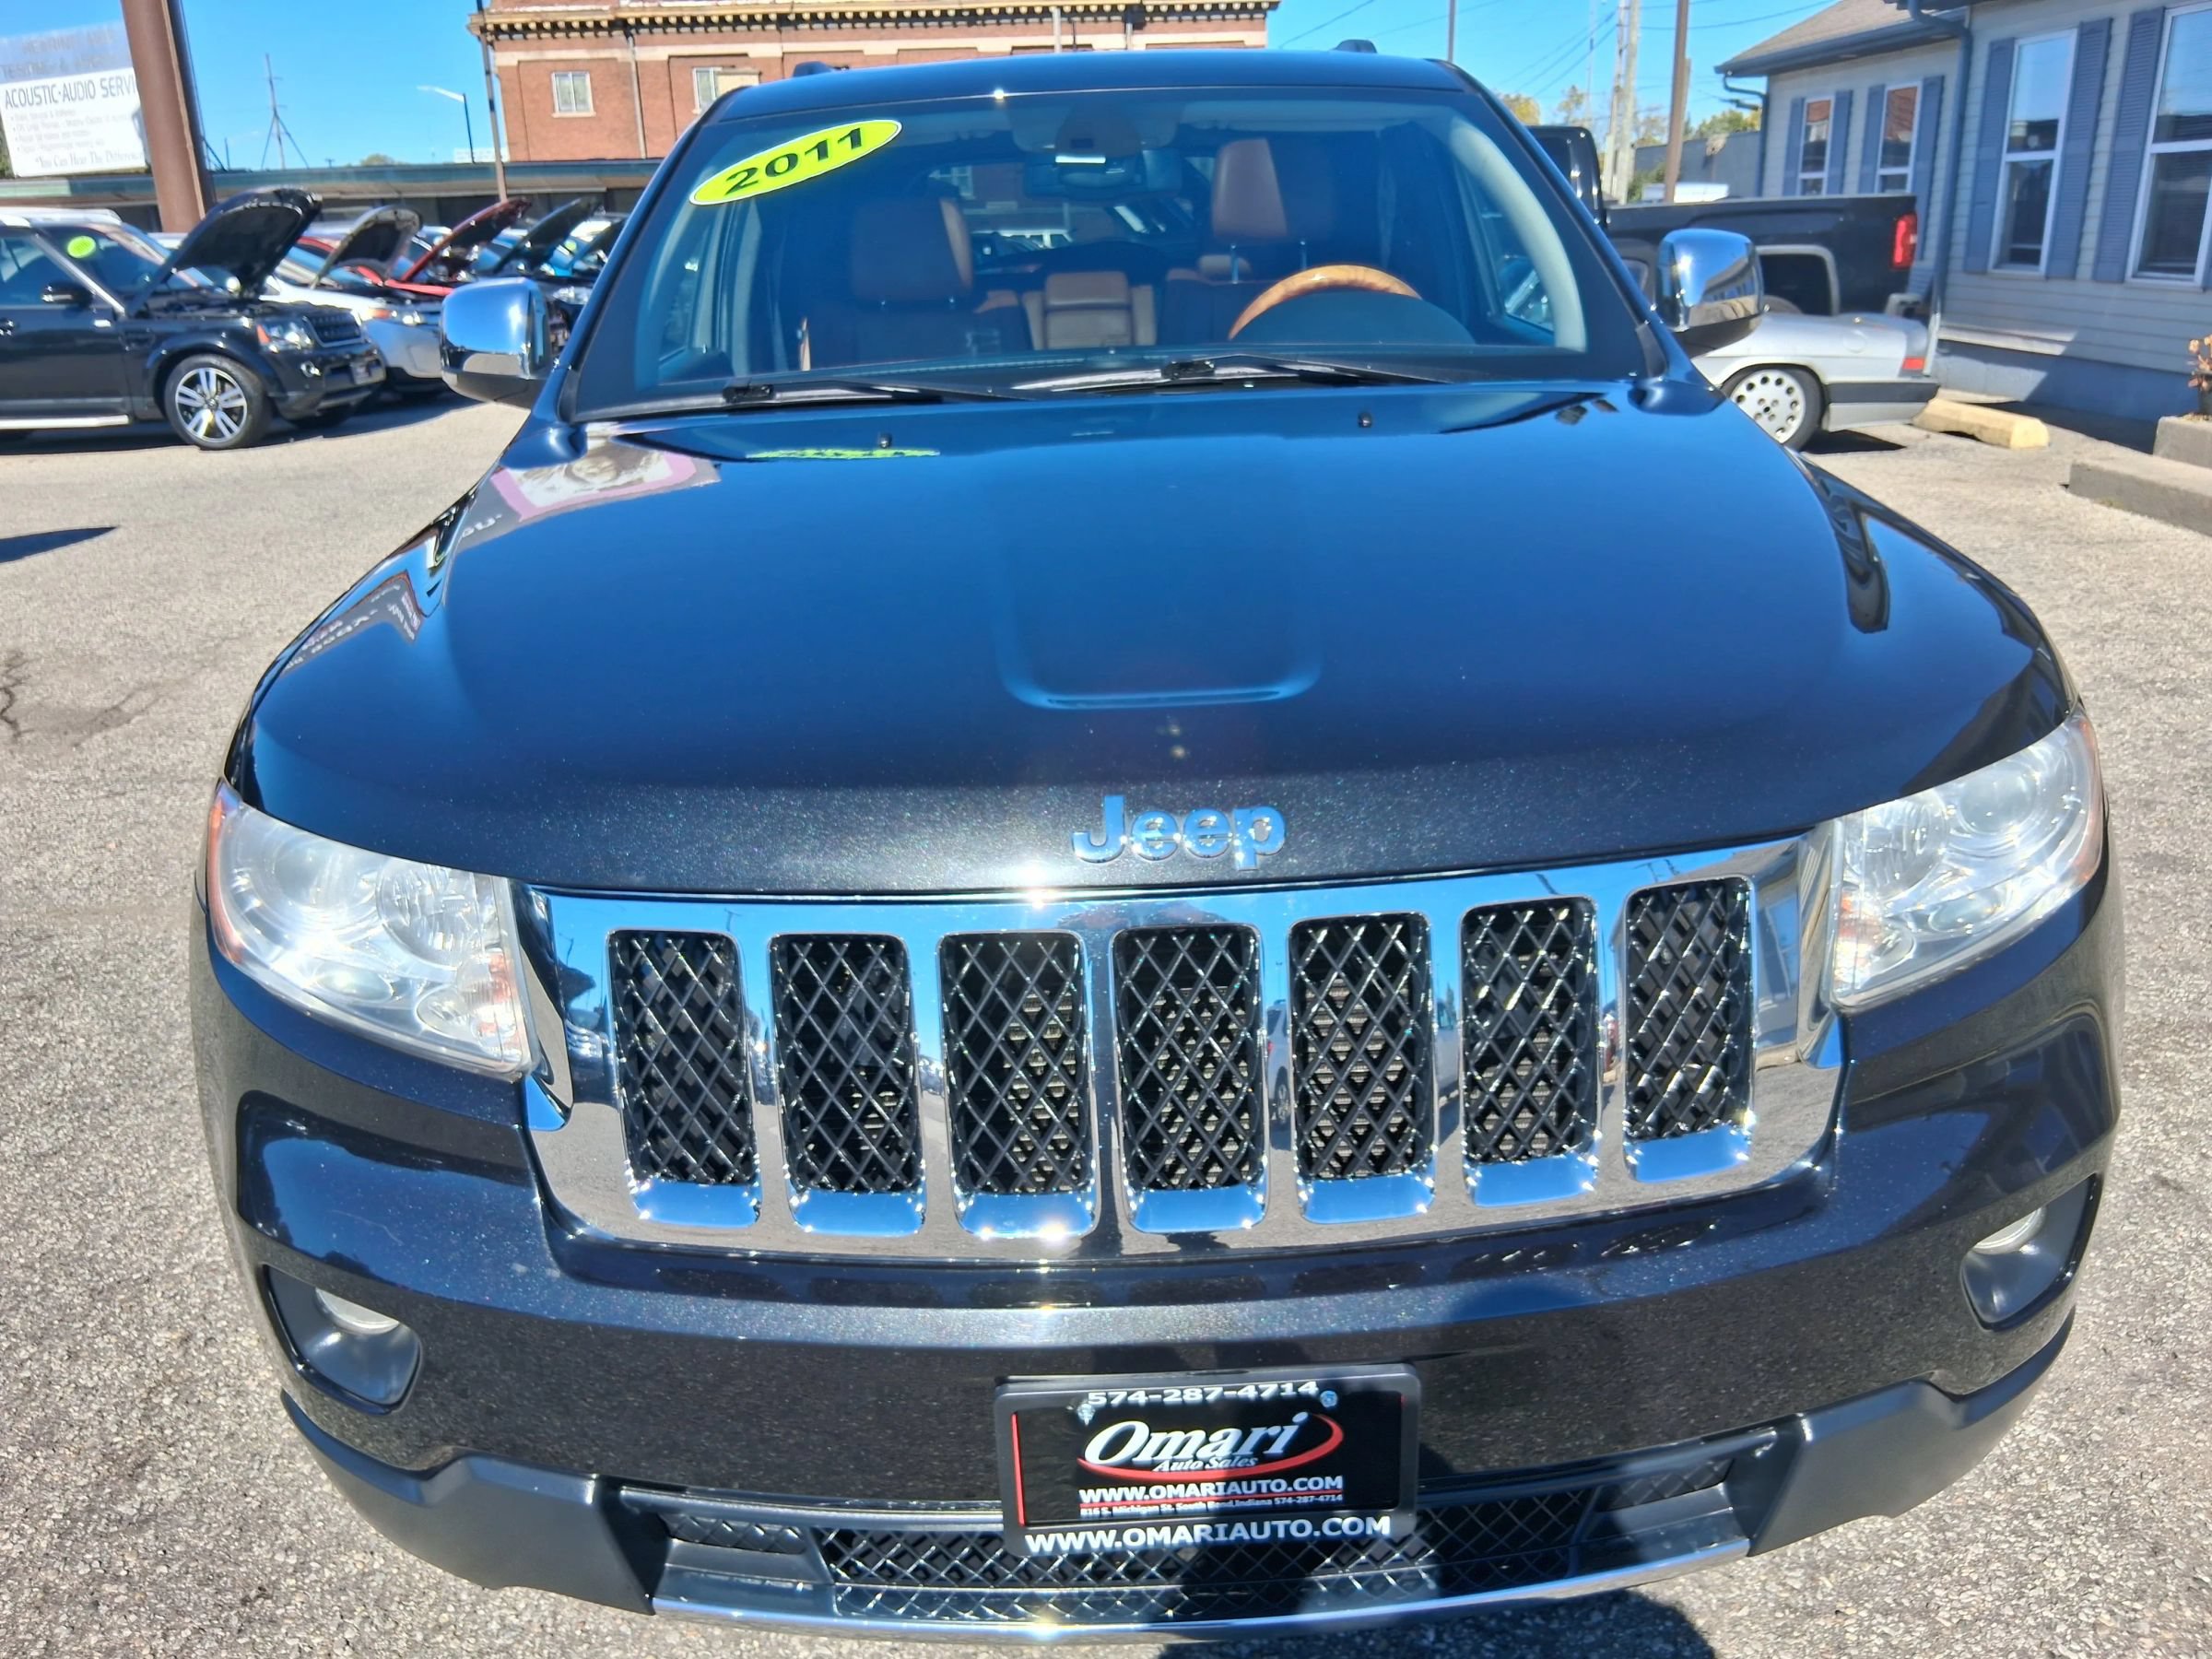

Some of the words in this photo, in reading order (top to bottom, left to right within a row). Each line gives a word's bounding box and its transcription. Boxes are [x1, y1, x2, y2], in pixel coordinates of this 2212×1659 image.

[100, 74, 136, 99] SERVI
[724, 127, 862, 196] 2011
[1072, 795, 1285, 871] Jeep
[1088, 1381, 1319, 1406] 574-287-4714
[1084, 1411, 1310, 1466] Omari
[1152, 1458, 1204, 1473] Auto
[1204, 1455, 1258, 1470] Sales
[1078, 1476, 1343, 1503] WWW.OMARIAUTO.COM
[1275, 1494, 1343, 1505] 574-287-4714
[1025, 1516, 1391, 1553] WWW.OMARIAUTO.COM
